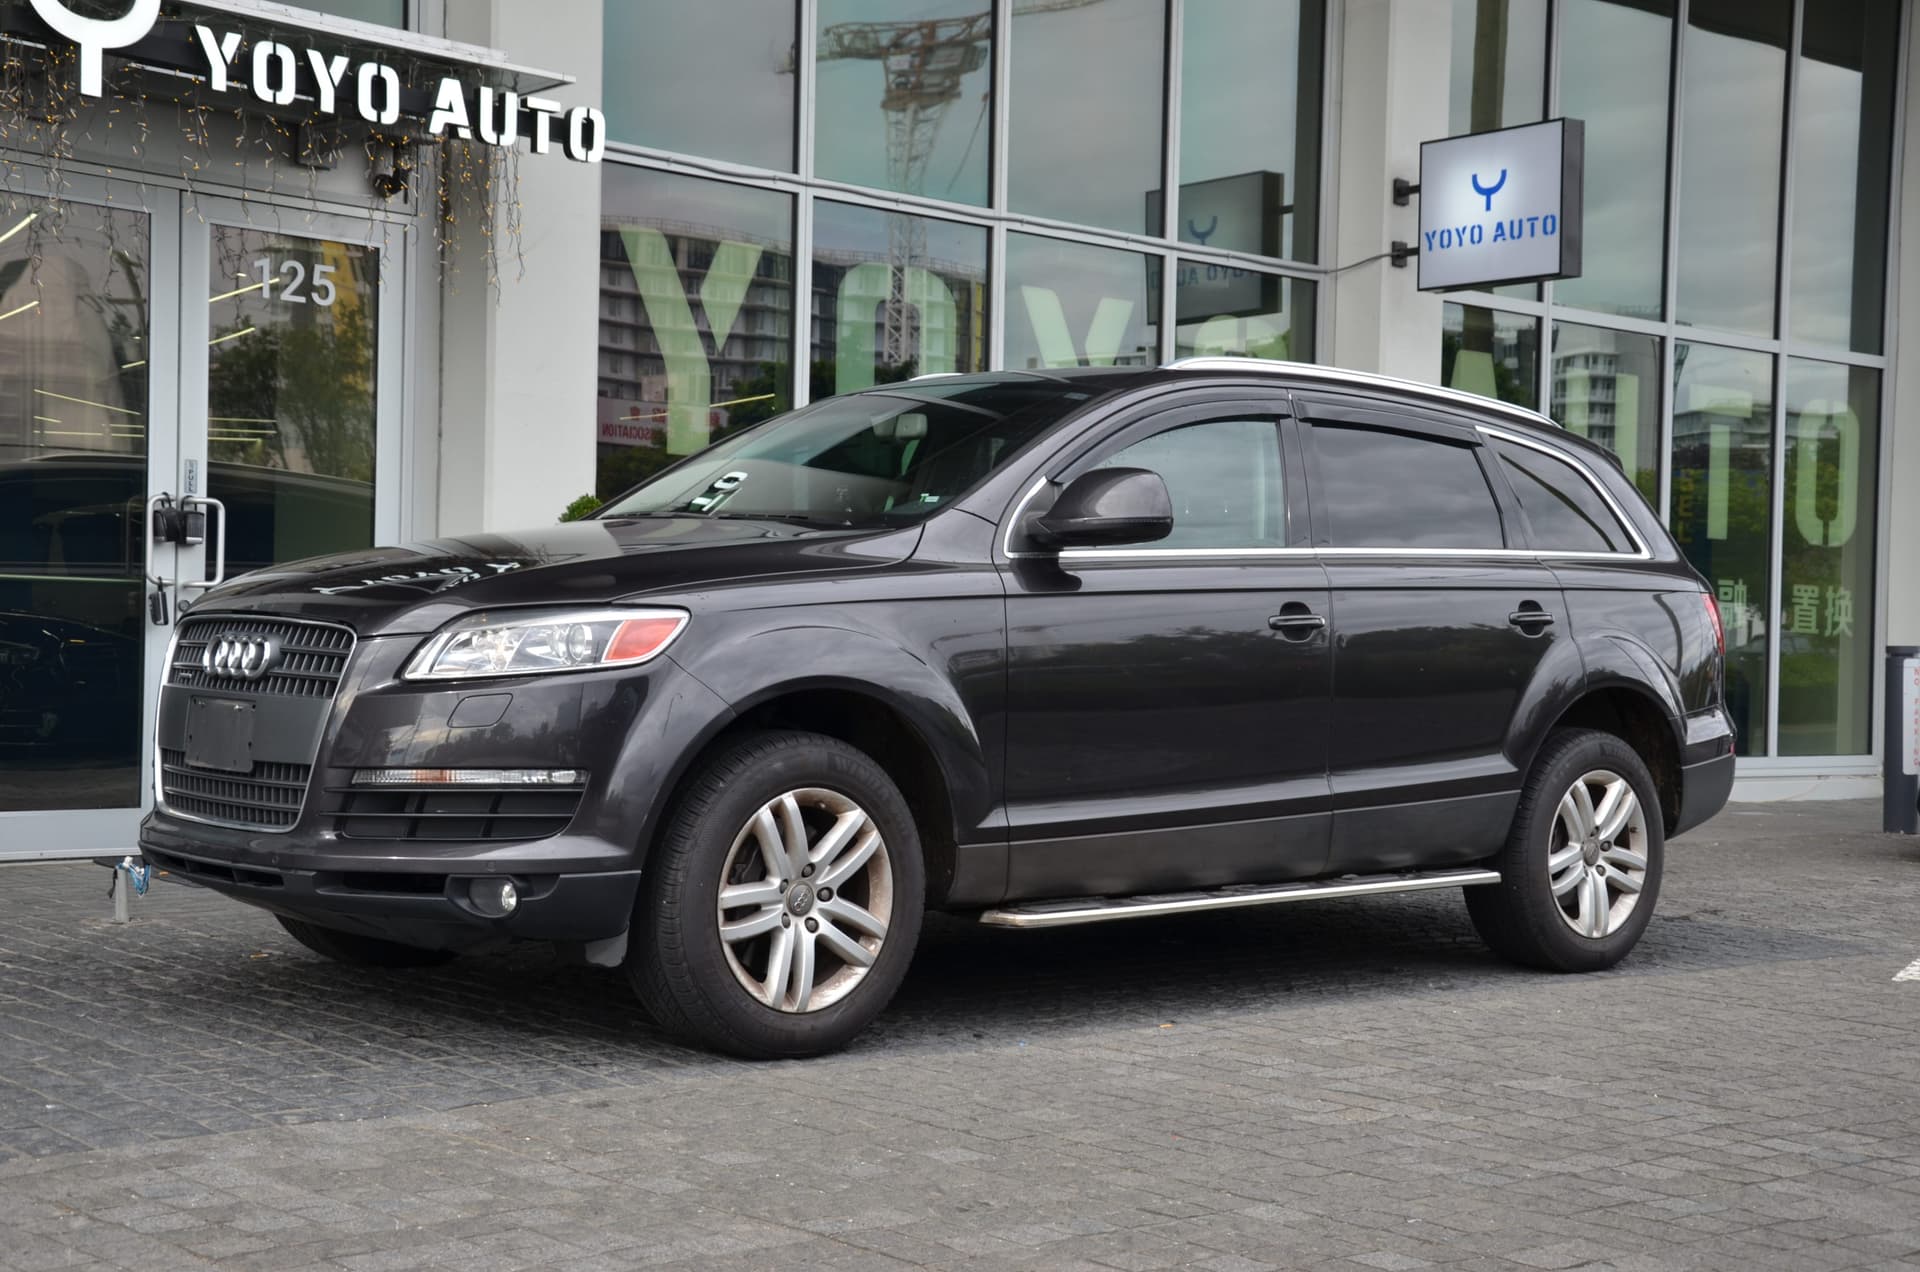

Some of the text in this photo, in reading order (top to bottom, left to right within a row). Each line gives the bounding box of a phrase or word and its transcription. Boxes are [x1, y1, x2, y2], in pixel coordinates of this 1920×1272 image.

[195, 25, 606, 162] YOYO AUTO
[1424, 213, 1557, 252] YOYO AUTO
[254, 257, 337, 306] 125
[1792, 584, 1853, 638] 置换
